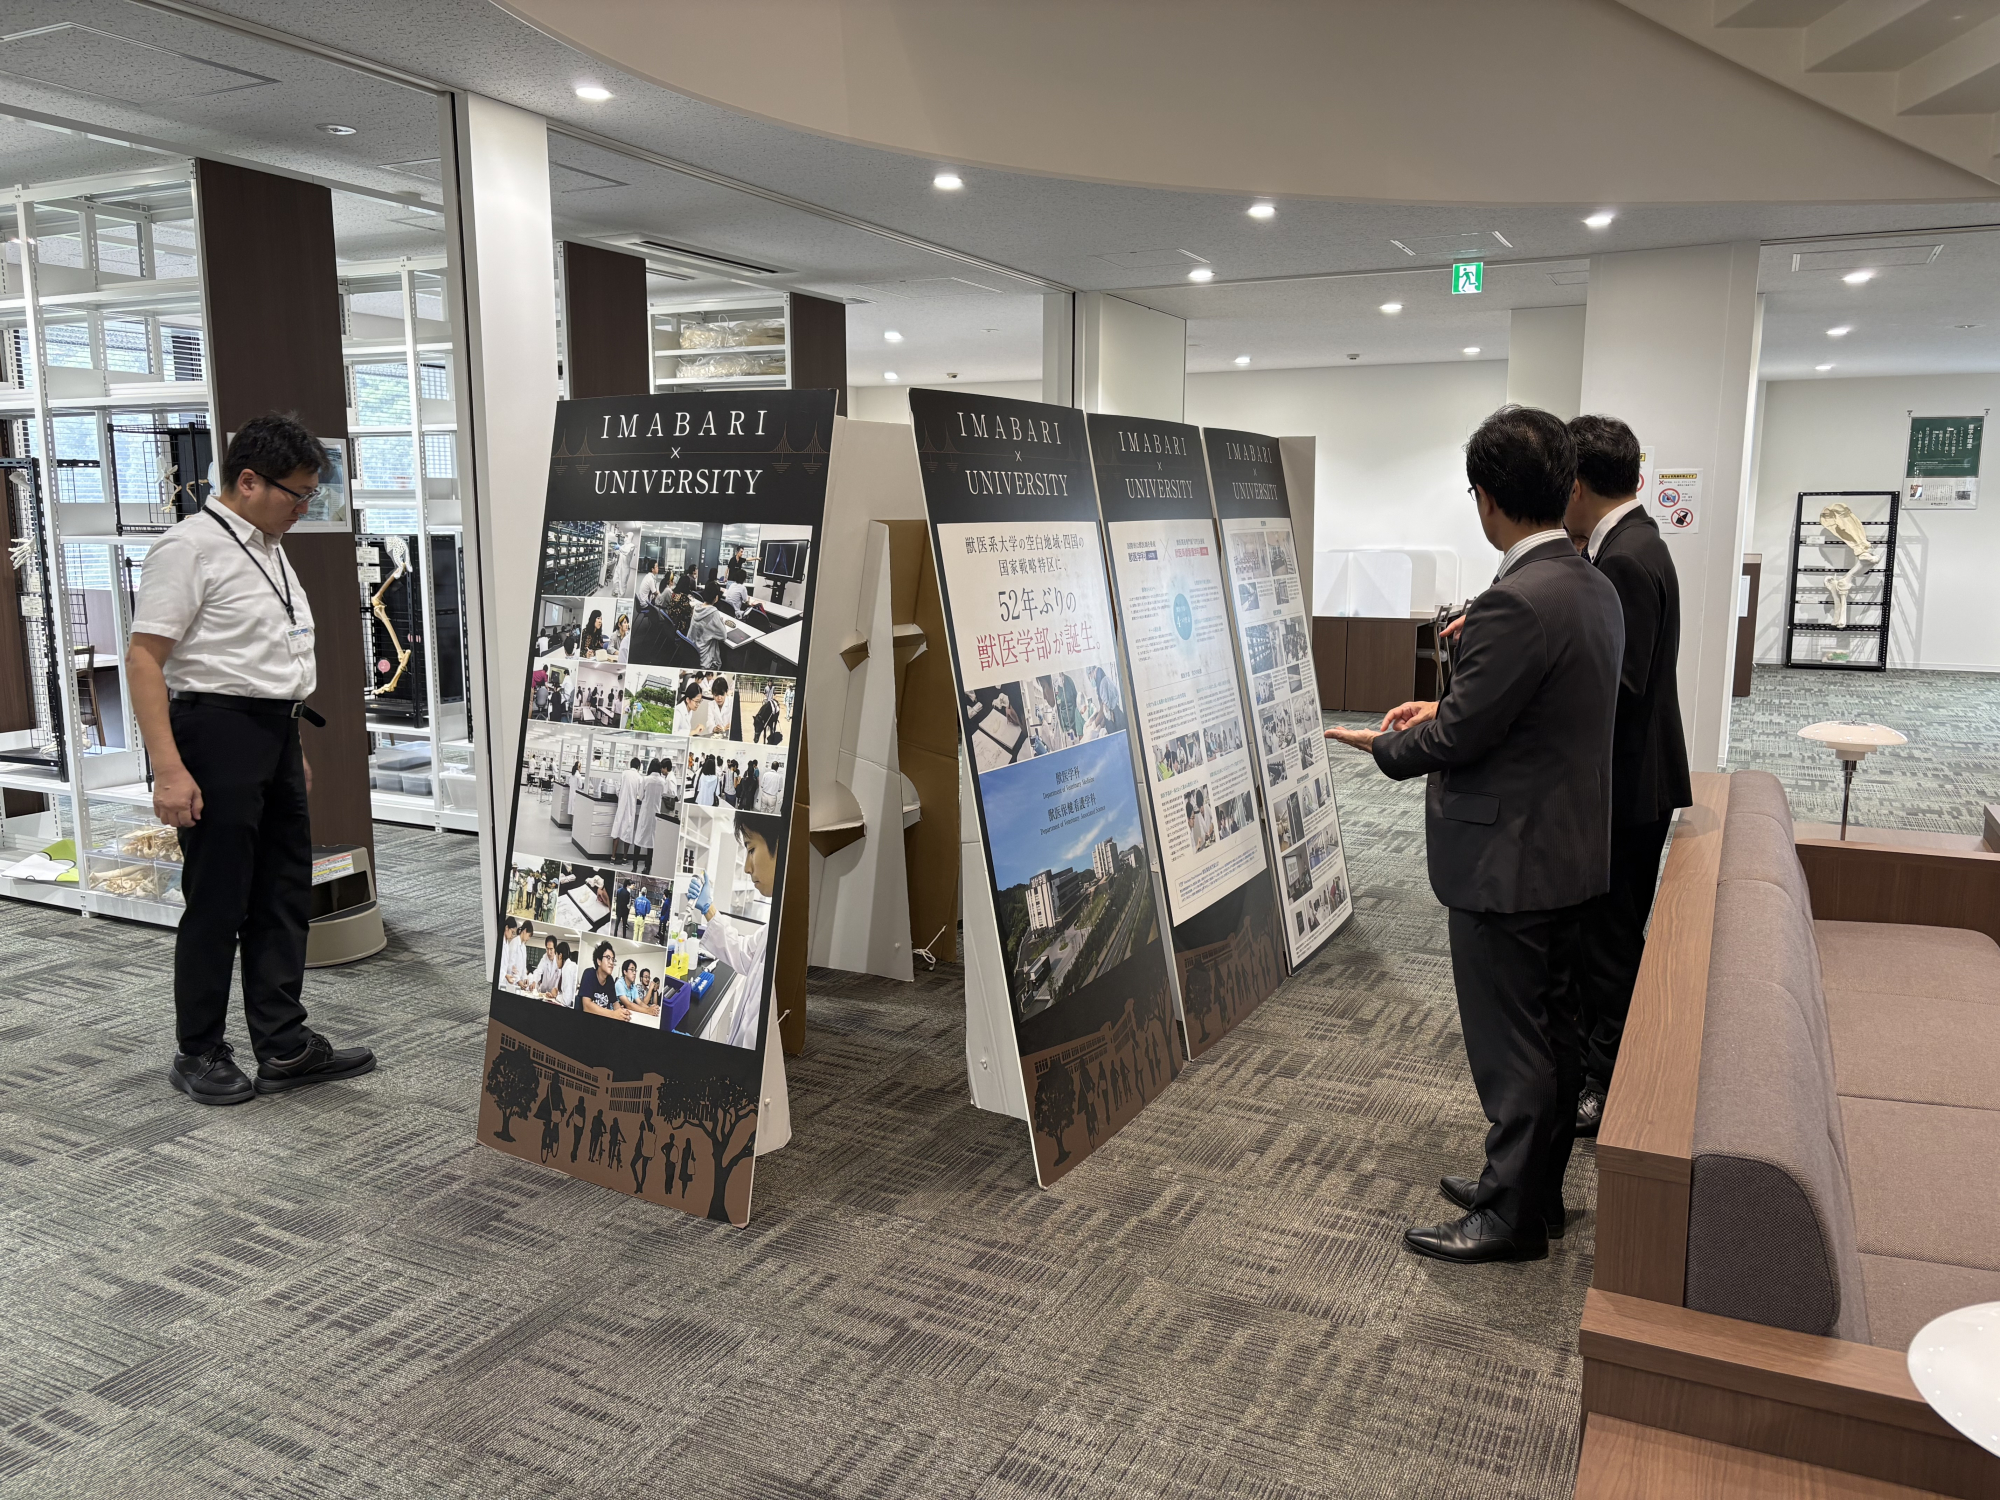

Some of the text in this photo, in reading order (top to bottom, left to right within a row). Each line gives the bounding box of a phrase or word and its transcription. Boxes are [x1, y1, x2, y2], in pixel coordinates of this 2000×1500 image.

[601, 411, 767, 439] IMABARI
[957, 411, 1062, 445] IMABARI
[1118, 431, 1187, 457] IMABARI
[1226, 442, 1273, 464] IMABARI
[594, 469, 763, 494] UNIVERSITY
[965, 470, 1068, 497] UNIVERSITY
[1125, 478, 1193, 499] UNIVERSITY
[1232, 482, 1278, 500] UNIVERSITY
[998, 557, 1067, 576] 国家戦略特区に、
[998, 587, 1077, 622] 52年ぶりの
[976, 621, 1101, 671] 獣医学部が誕生。
[1056, 766, 1080, 785] 獣医学科
